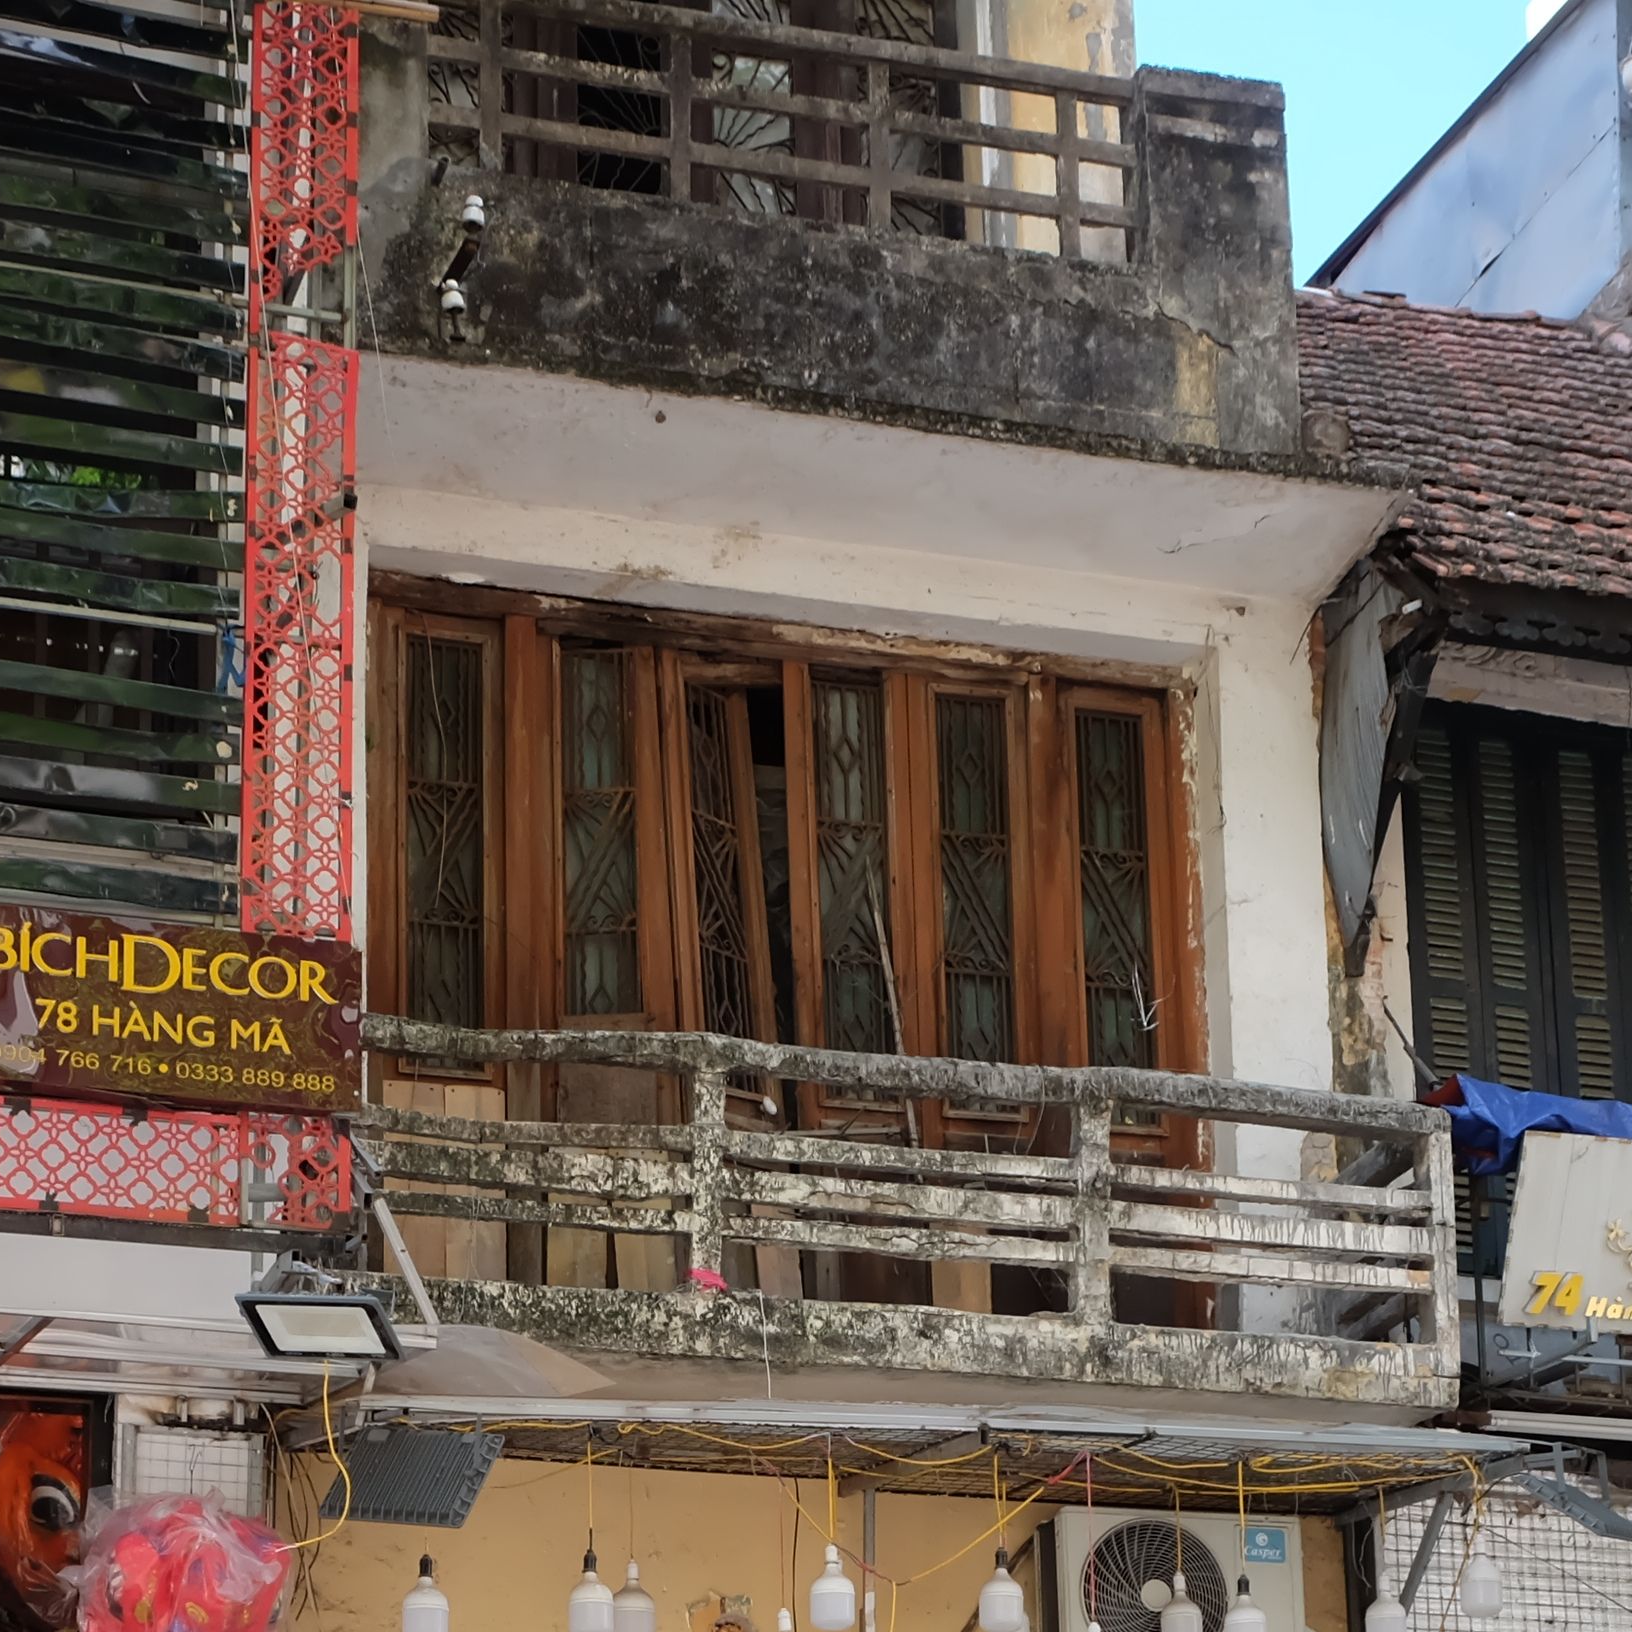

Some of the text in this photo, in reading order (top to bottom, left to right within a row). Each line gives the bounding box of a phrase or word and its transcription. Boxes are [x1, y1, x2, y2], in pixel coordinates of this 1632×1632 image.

[35, 998, 291, 1055] 78 HÀNG MÃ
[57, 1048, 100, 1070] 766
[112, 1054, 152, 1076] 716
[176, 1061, 234, 1084] 0333
[242, 1065, 285, 1088] 889
[292, 1071, 336, 1094] 888
[1524, 1271, 1584, 1315] 74
